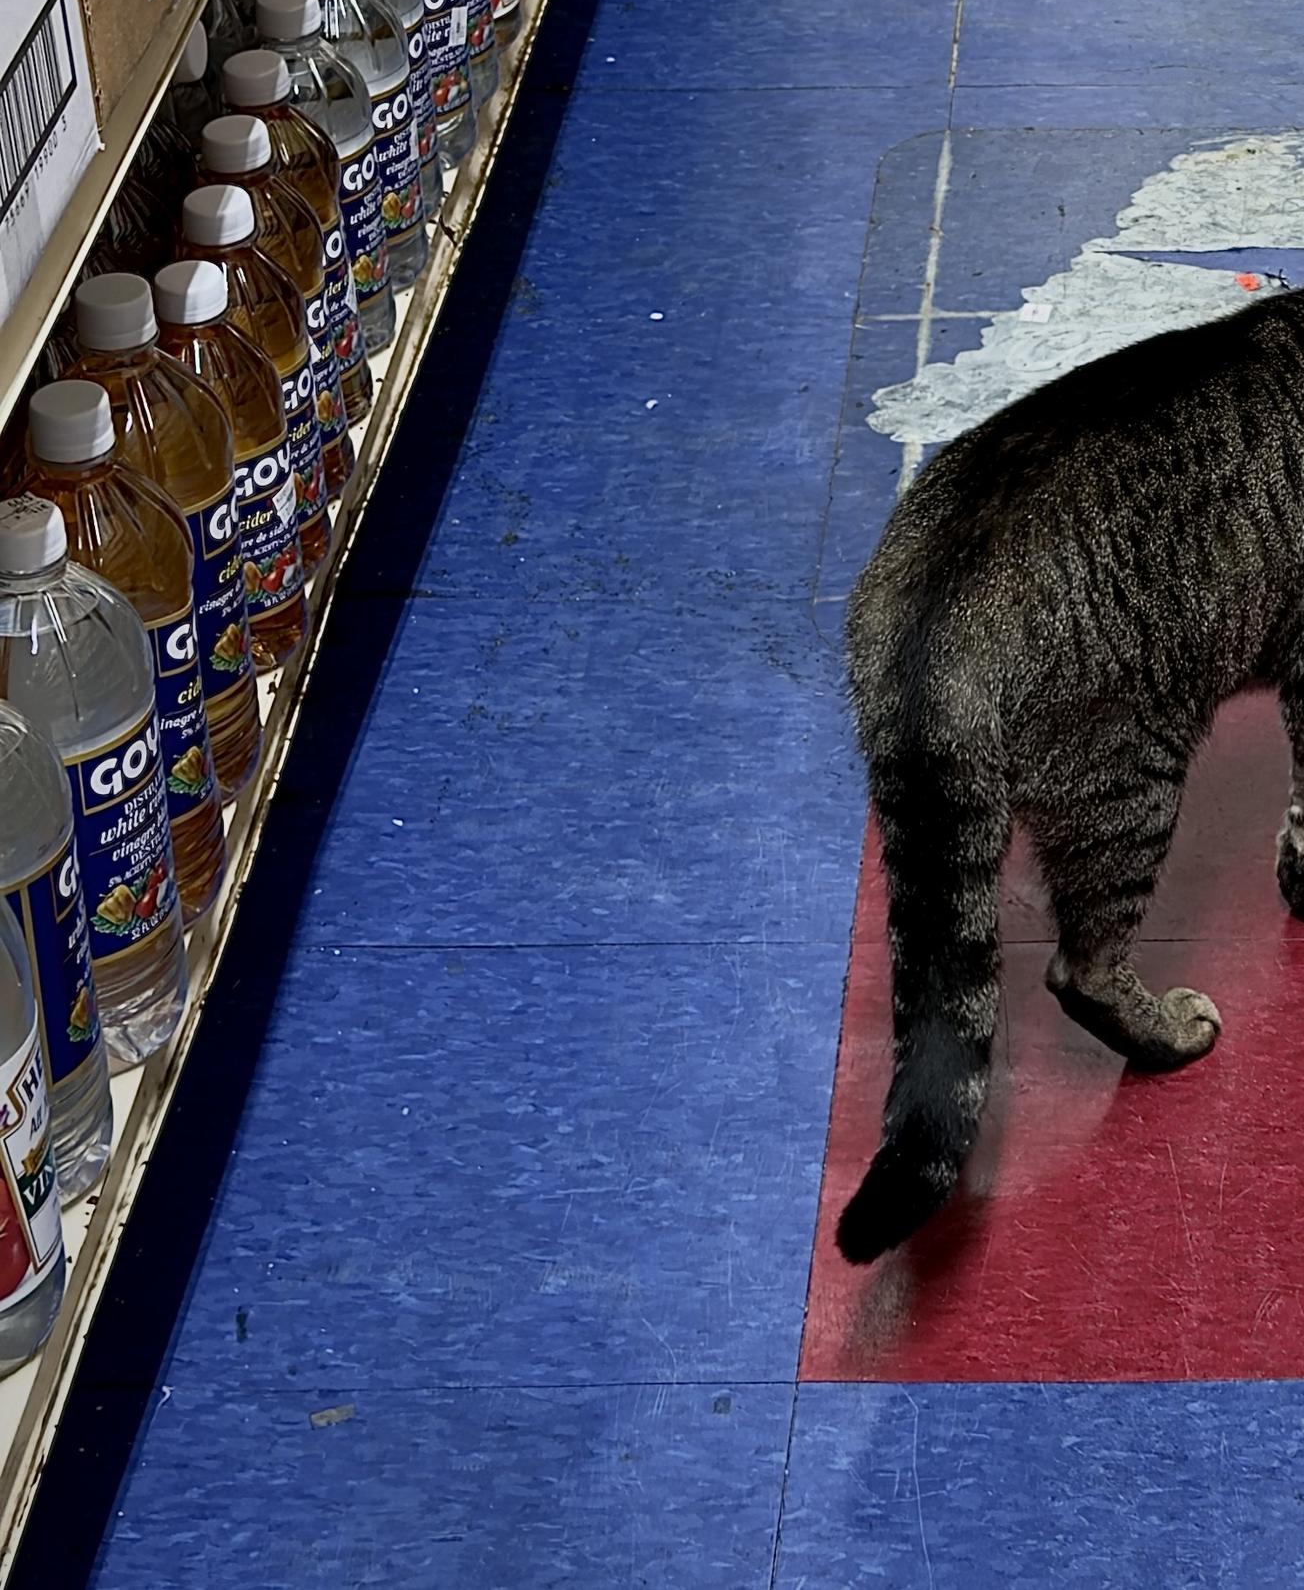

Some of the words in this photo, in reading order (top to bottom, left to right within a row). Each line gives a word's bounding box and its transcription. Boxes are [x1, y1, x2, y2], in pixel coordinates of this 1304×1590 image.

[343, 151, 378, 192] GO
[235, 441, 292, 498] GOY
[91, 724, 158, 796] GOY
[100, 806, 148, 847] white
